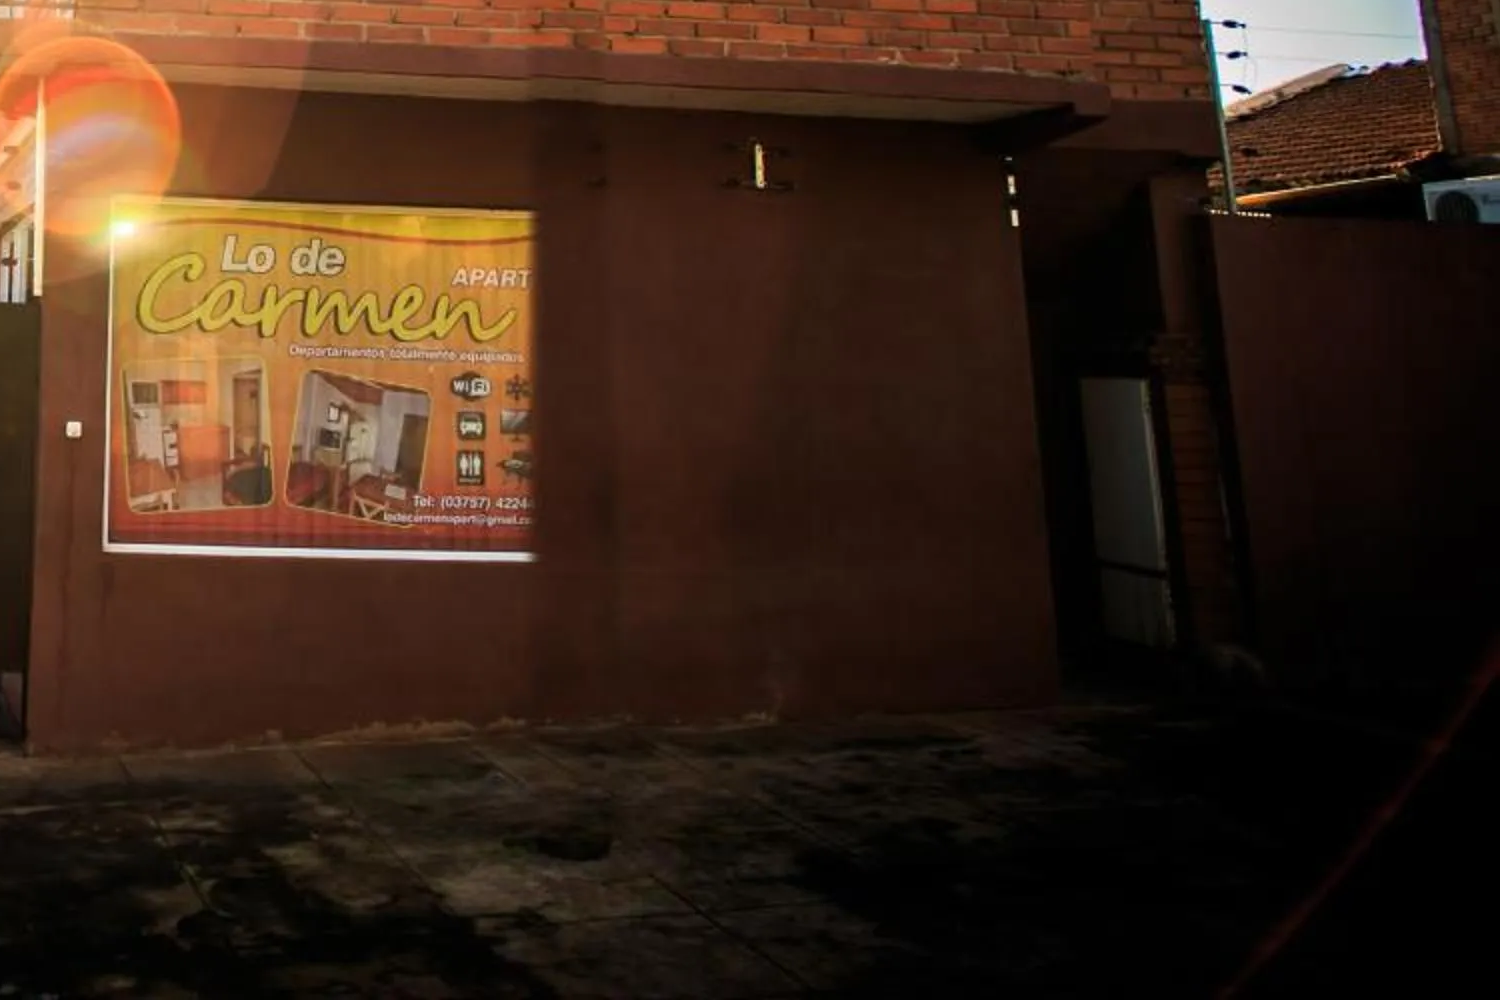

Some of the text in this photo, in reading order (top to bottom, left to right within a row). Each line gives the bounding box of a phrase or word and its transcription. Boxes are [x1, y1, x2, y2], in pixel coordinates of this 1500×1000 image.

[220, 234, 346, 276] Lo de
[451, 267, 532, 289] APART
[135, 251, 518, 343] Carmen
[288, 344, 386, 361] Departamentos
[389, 347, 457, 362] totalmente
[412, 494, 435, 508] Tel:
